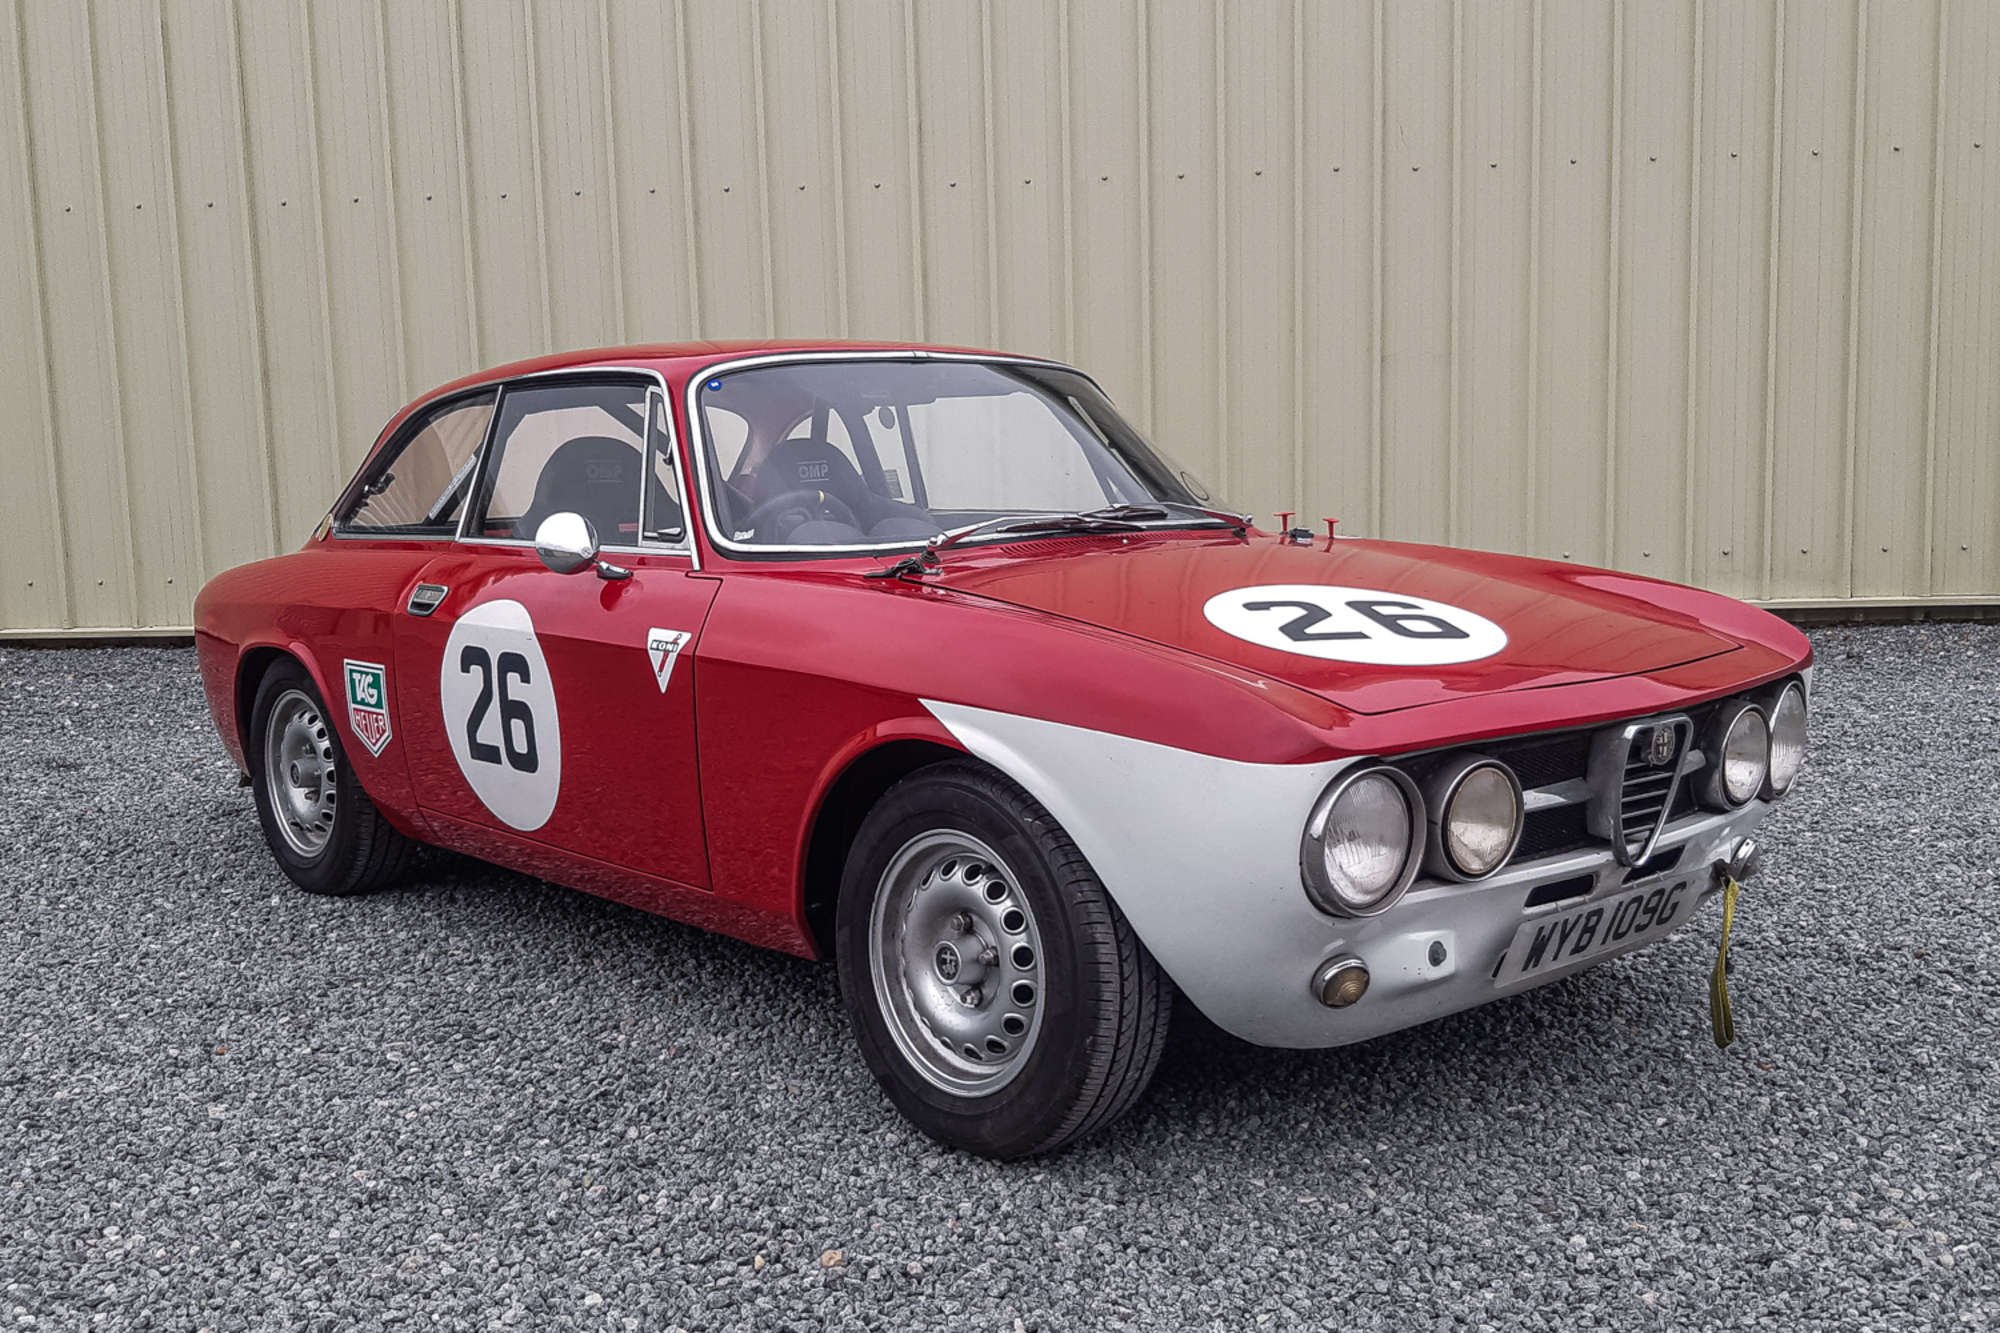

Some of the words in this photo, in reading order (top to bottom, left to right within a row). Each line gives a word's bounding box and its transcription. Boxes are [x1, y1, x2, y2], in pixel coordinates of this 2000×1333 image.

[799, 463, 828, 479] OMP
[1242, 600, 1470, 641] 26
[651, 640, 679, 653] KONI
[352, 672, 378, 705] TAG
[460, 645, 539, 774] 26
[354, 710, 386, 743] HEUER
[1521, 907, 1604, 972] WYB
[1600, 881, 1687, 945] 109G
